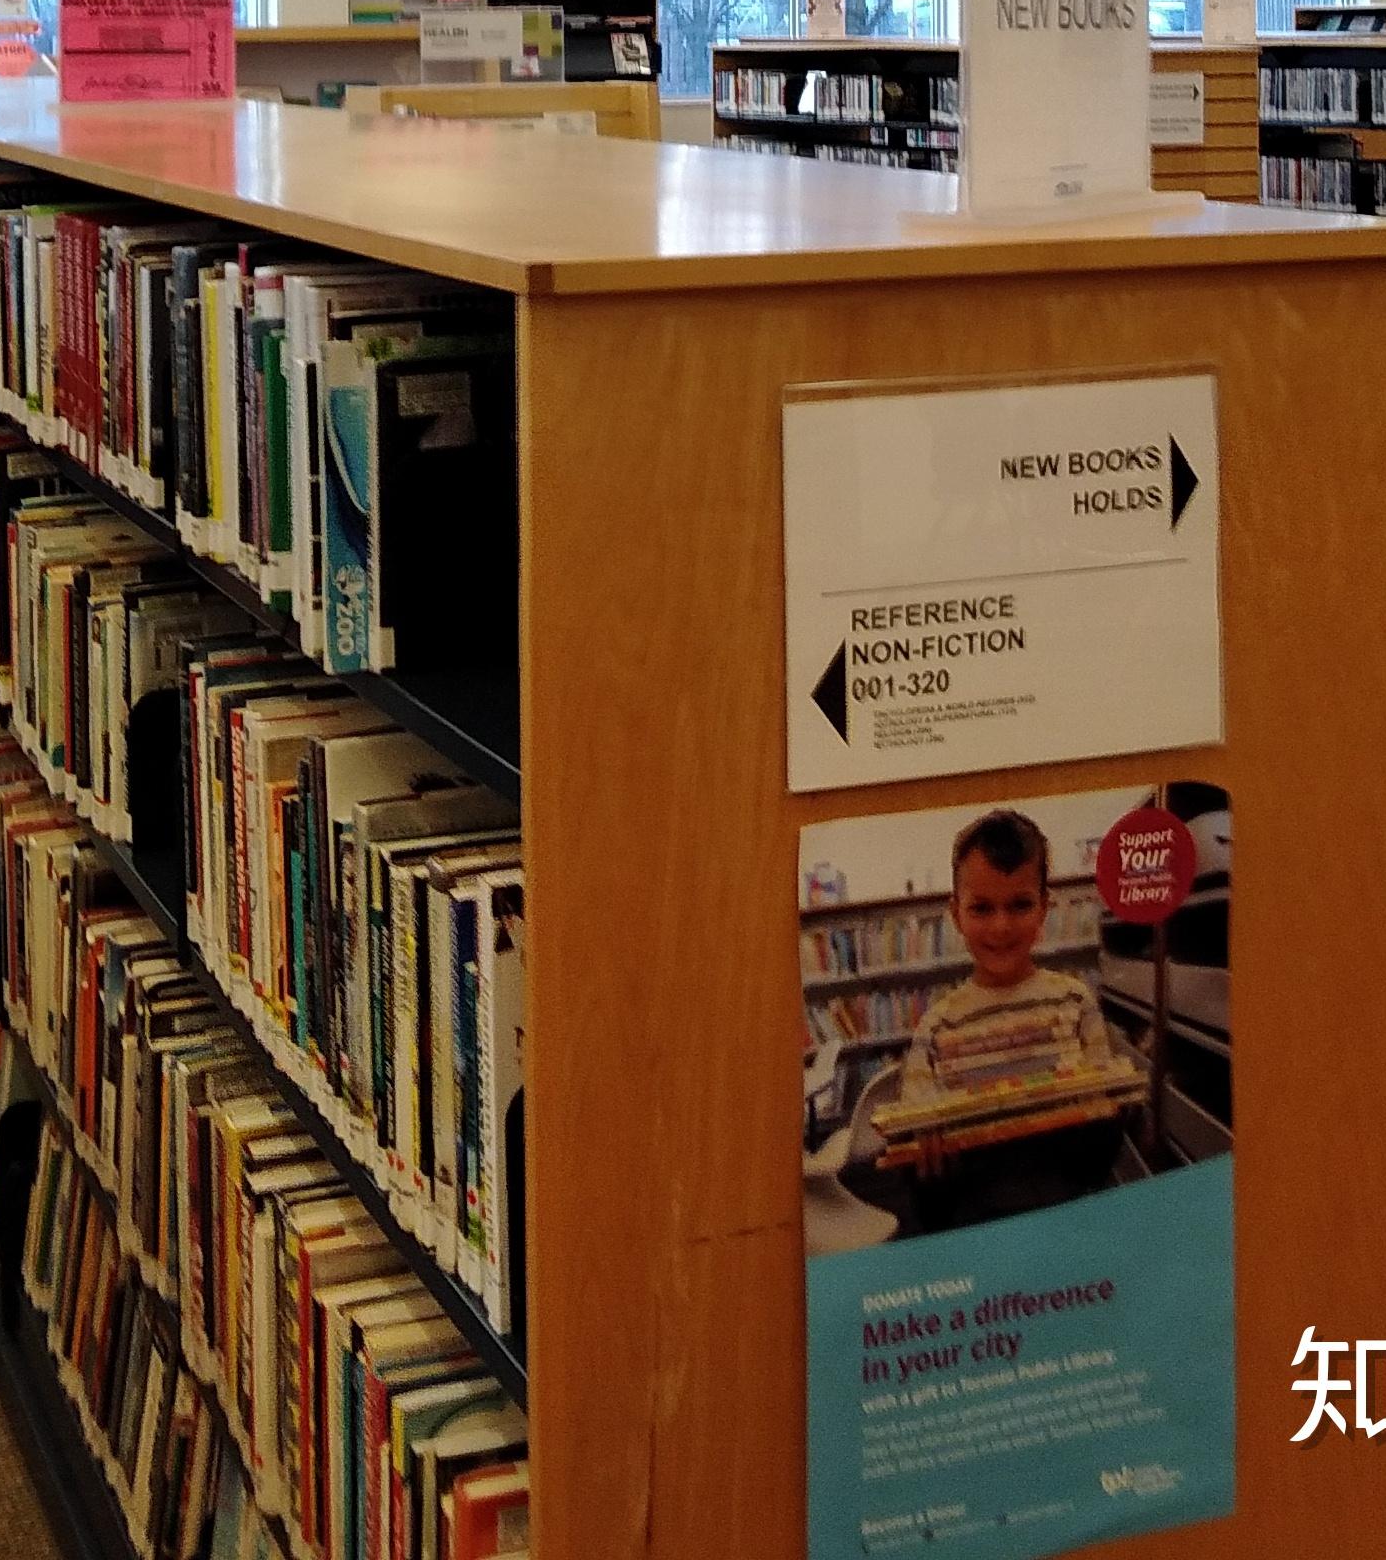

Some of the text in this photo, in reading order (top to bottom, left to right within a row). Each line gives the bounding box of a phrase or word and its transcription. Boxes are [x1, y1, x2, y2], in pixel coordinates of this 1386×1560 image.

[1000, 445, 1162, 481] NEW BOOKS
[1073, 485, 1163, 516] HOLDS
[851, 594, 1015, 633] REFERENCE
[852, 627, 1025, 666] NON-FICTION
[852, 668, 951, 702] 001-320
[1118, 828, 1174, 849] Support
[1120, 848, 1171, 871] Your
[1119, 886, 1171, 905] Library
[863, 1278, 1117, 1349] Make a difference
[863, 1331, 1024, 1384] in your city
